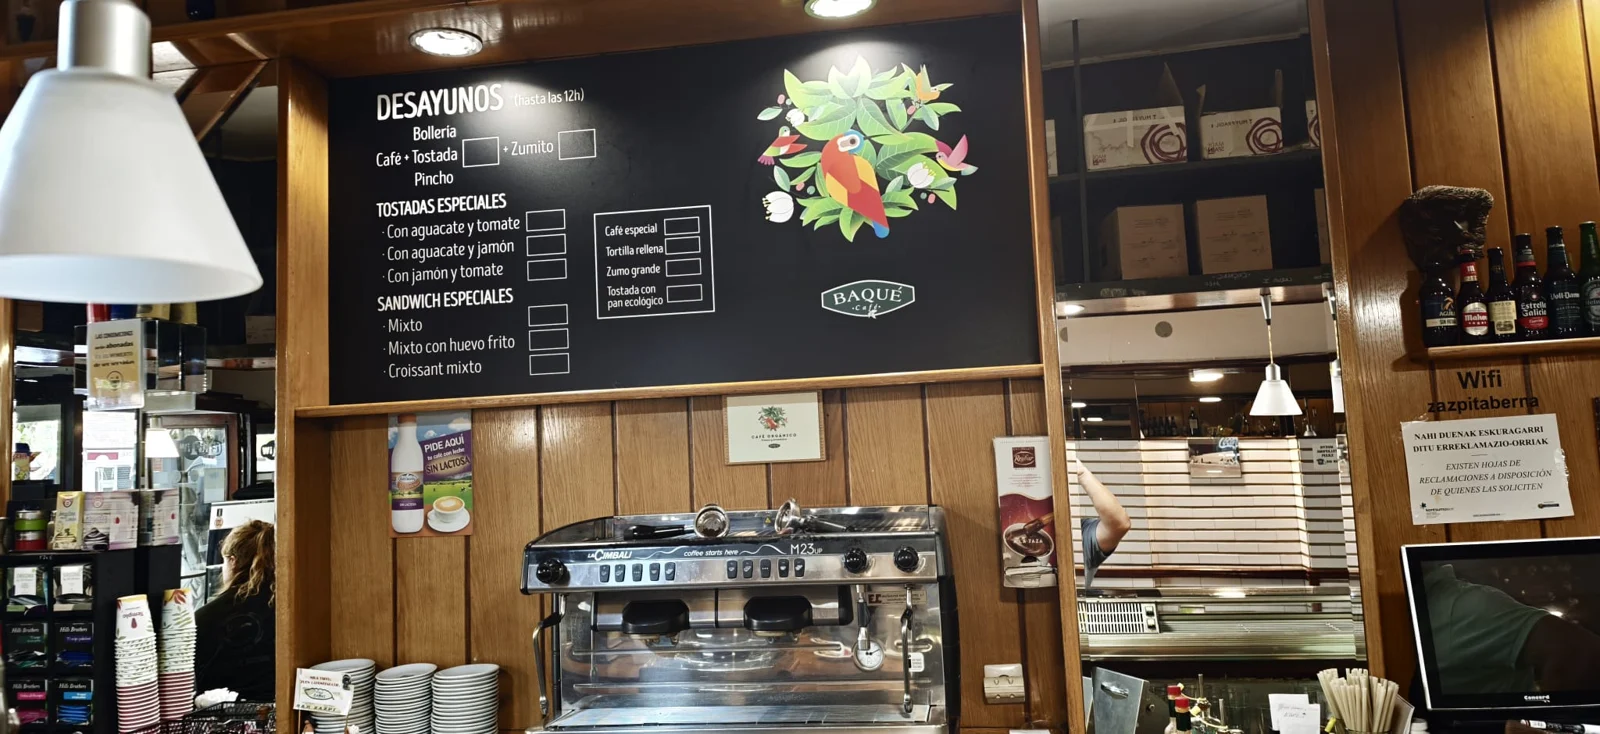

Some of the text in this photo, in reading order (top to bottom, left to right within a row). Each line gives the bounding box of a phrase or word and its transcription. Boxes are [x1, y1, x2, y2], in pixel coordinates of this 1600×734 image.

[377, 84, 585, 120] DESAYUNOS (hasta las 12h)
[376, 152, 401, 167] Café
[412, 147, 458, 164] Tostada
[511, 140, 554, 156] Zumito
[415, 170, 454, 186] Pincho
[377, 193, 507, 217] TOSTADAS ESPECIALES
[387, 217, 521, 241] Con aguacate y tomate
[605, 223, 658, 238] Café especial
[388, 240, 515, 263] Con aguacate y jamón
[606, 244, 664, 257] Tortilla rellena
[388, 263, 504, 286] Con jamón y tomate
[607, 264, 661, 279] Zumo grande
[378, 288, 514, 312] SANDWICH ESPECIALES
[607, 285, 656, 297] Tostada con
[833, 286, 903, 306] BAQUÉ
[608, 296, 664, 311] pan ecológico
[388, 319, 423, 333] Mixto
[389, 335, 516, 356] Mixto con huevo frito
[389, 361, 482, 379] Croissant mixto
[1457, 369, 1502, 390] Wifi
[1428, 396, 1539, 414] zazpitaberna
[1414, 426, 1544, 441] NAHI DUENAK ESKURAGARRI
[424, 434, 465, 454] PIDE AQUÍ
[1413, 438, 1549, 453] DITU ERREKLAMAZIO-ORRIAK
[426, 455, 471, 475] SIN LACTOSA
[1446, 460, 1522, 471] EXISTEN HOJAS DE
[1419, 469, 1553, 485] RECLAMACIONES A DISPOSICIÓN
[1430, 483, 1544, 497] DE QUIENES LAS SOLICITEN
[595, 549, 633, 561] CIMBALI
